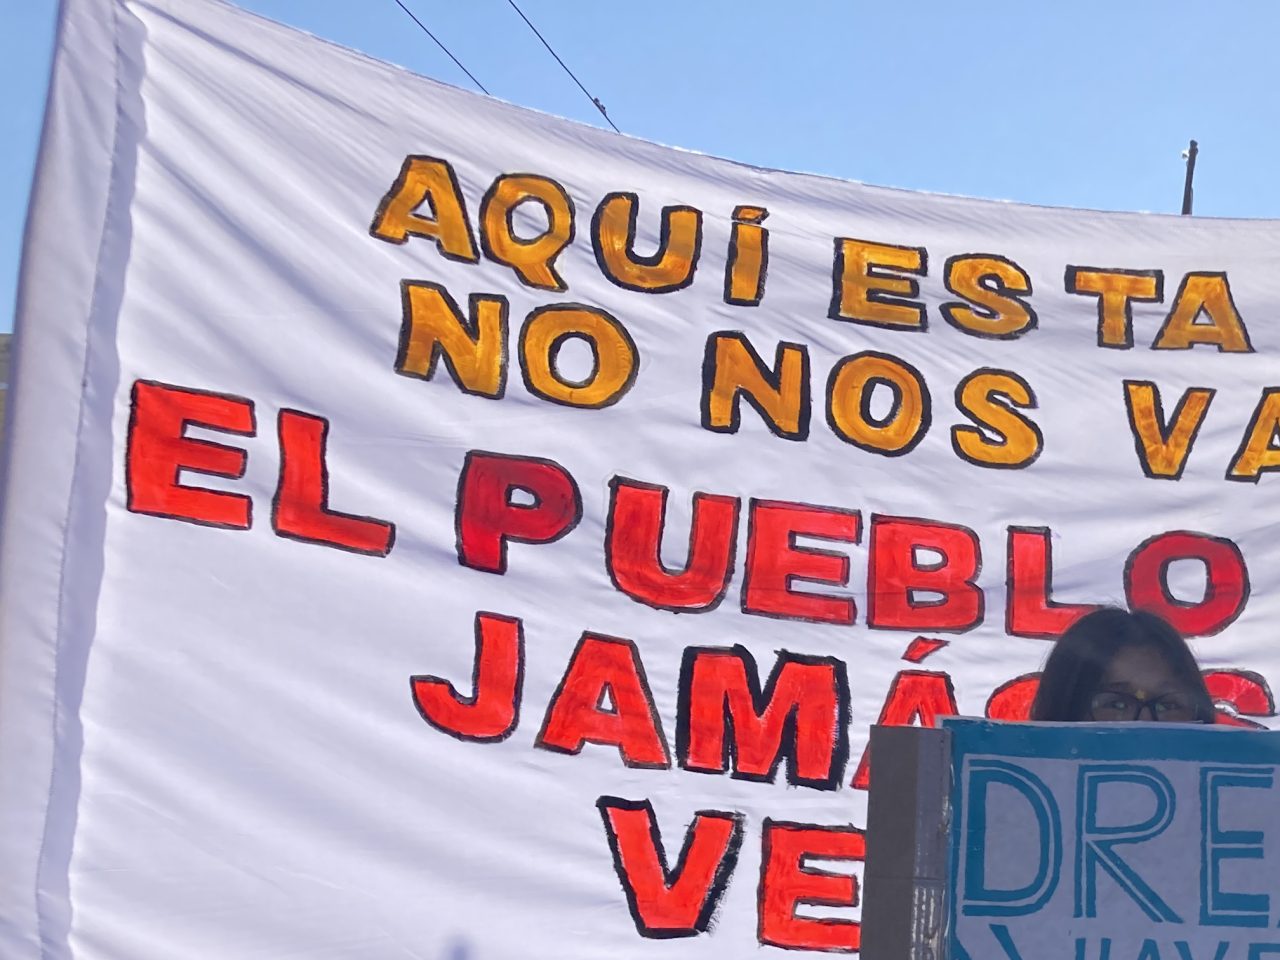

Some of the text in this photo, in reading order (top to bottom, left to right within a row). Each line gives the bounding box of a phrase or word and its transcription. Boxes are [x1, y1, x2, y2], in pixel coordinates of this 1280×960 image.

[394, 279, 640, 409] NO
[701, 329, 1044, 469] NOS
[127, 379, 396, 557] EL
[455, 449, 1250, 639] PUEBLO
